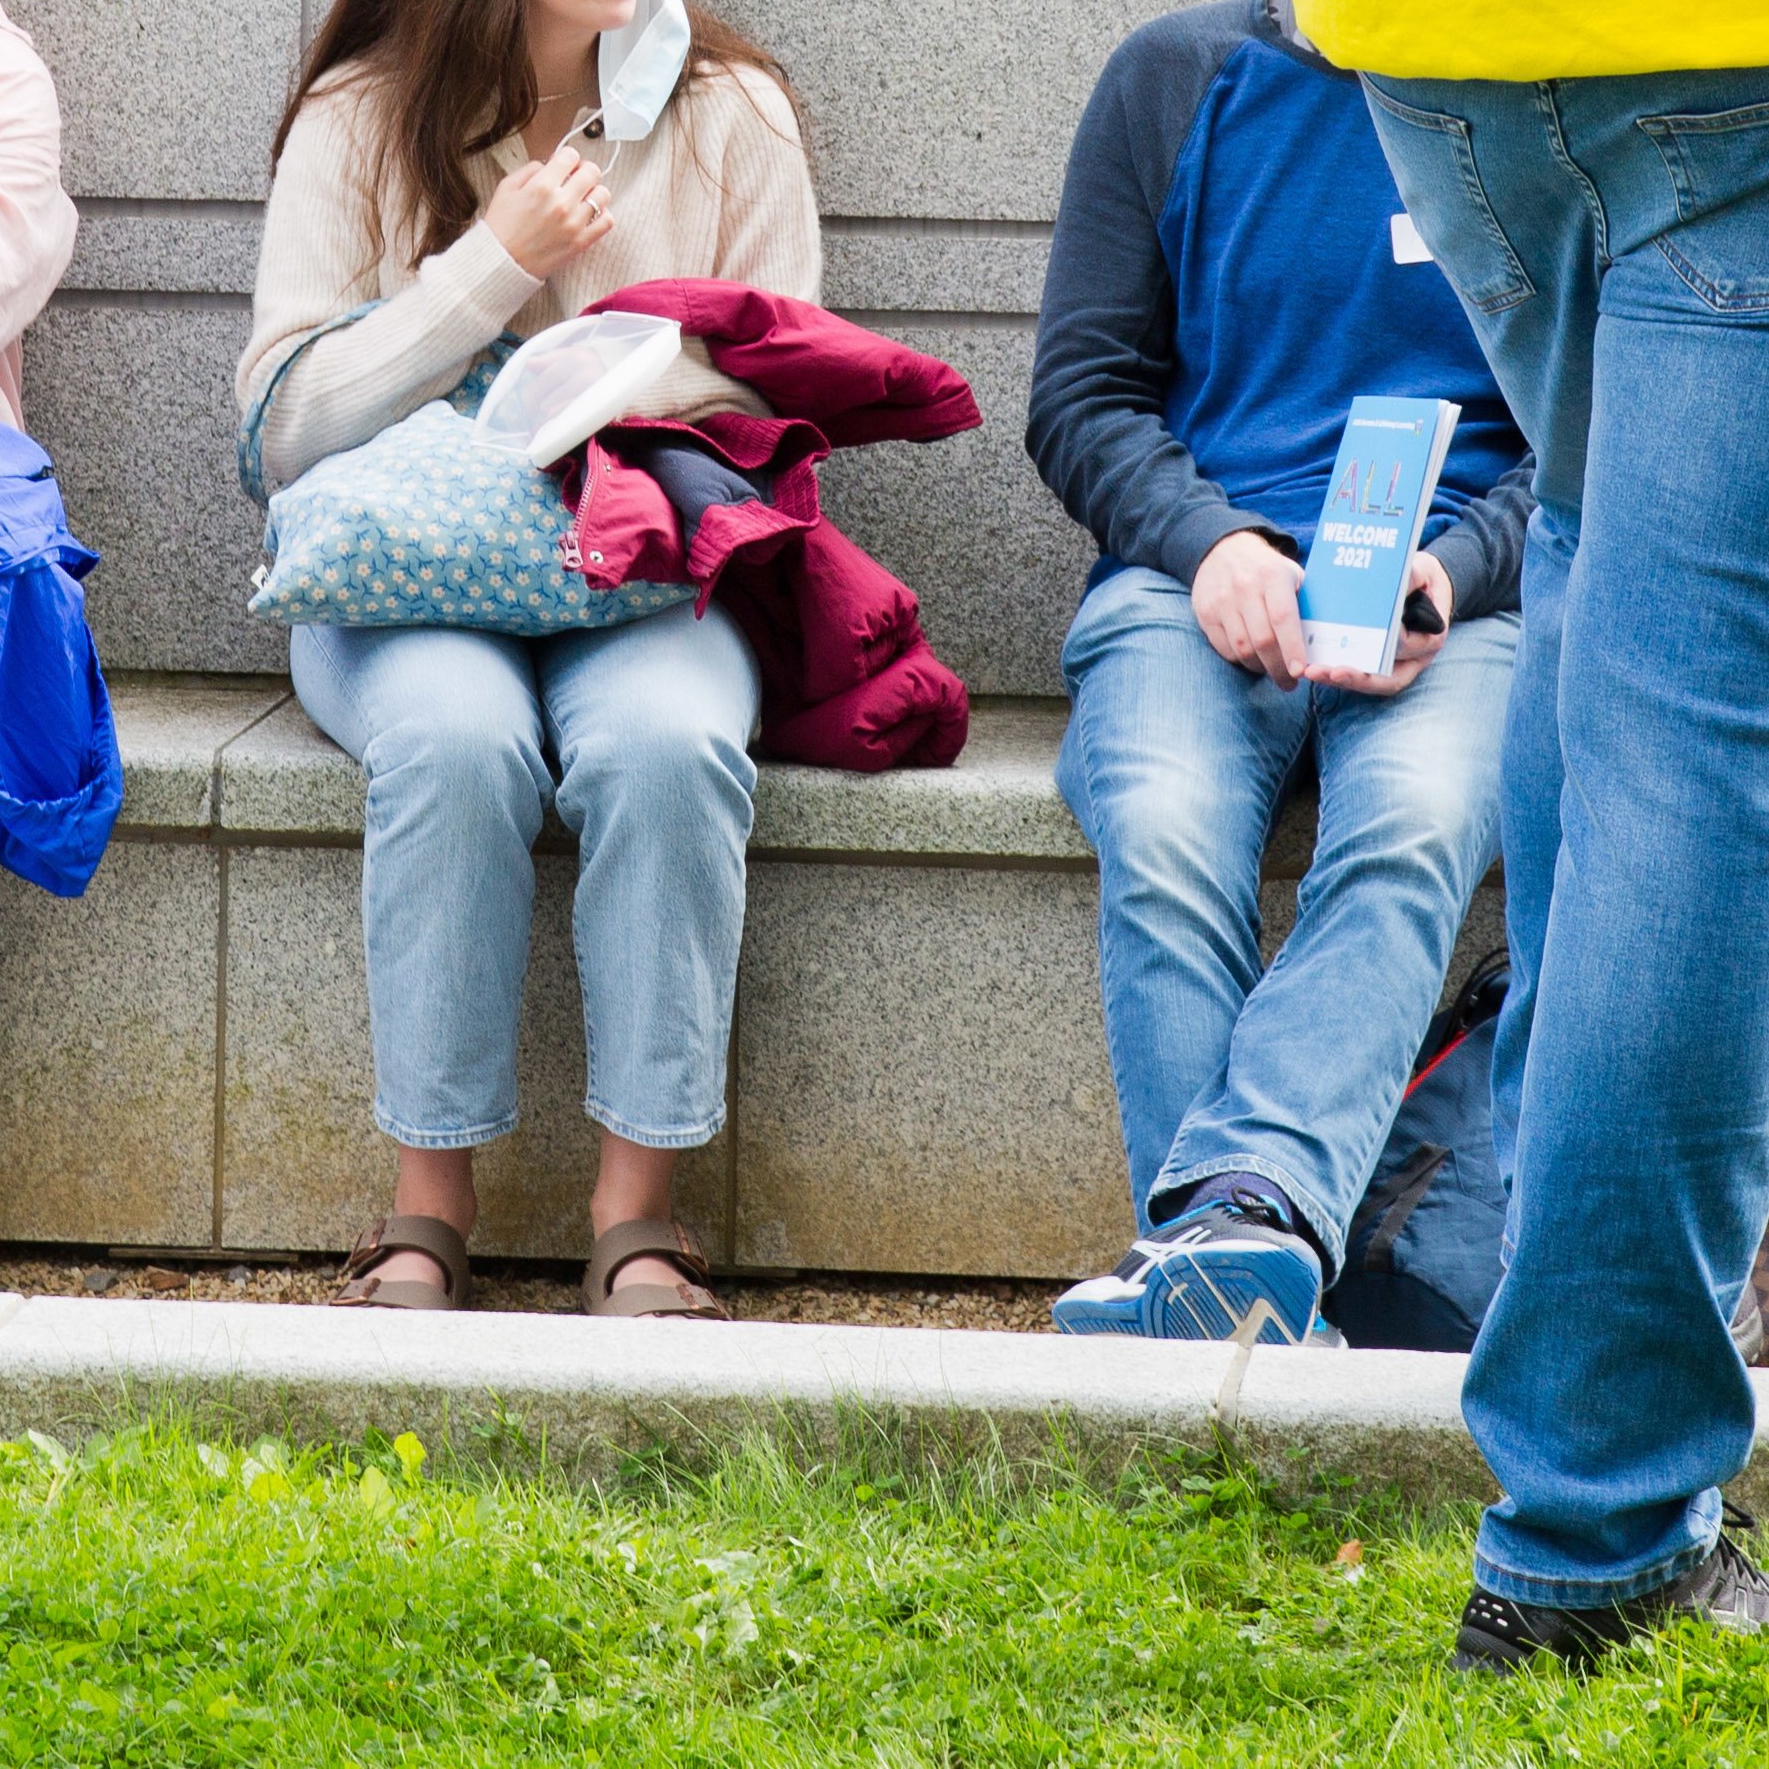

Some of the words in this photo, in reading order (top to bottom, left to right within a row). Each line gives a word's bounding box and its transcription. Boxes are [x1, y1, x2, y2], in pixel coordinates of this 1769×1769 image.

[1329, 457, 1404, 516] ALL
[1322, 522, 1398, 548] WELCOME
[1333, 546, 1372, 569] 2021
